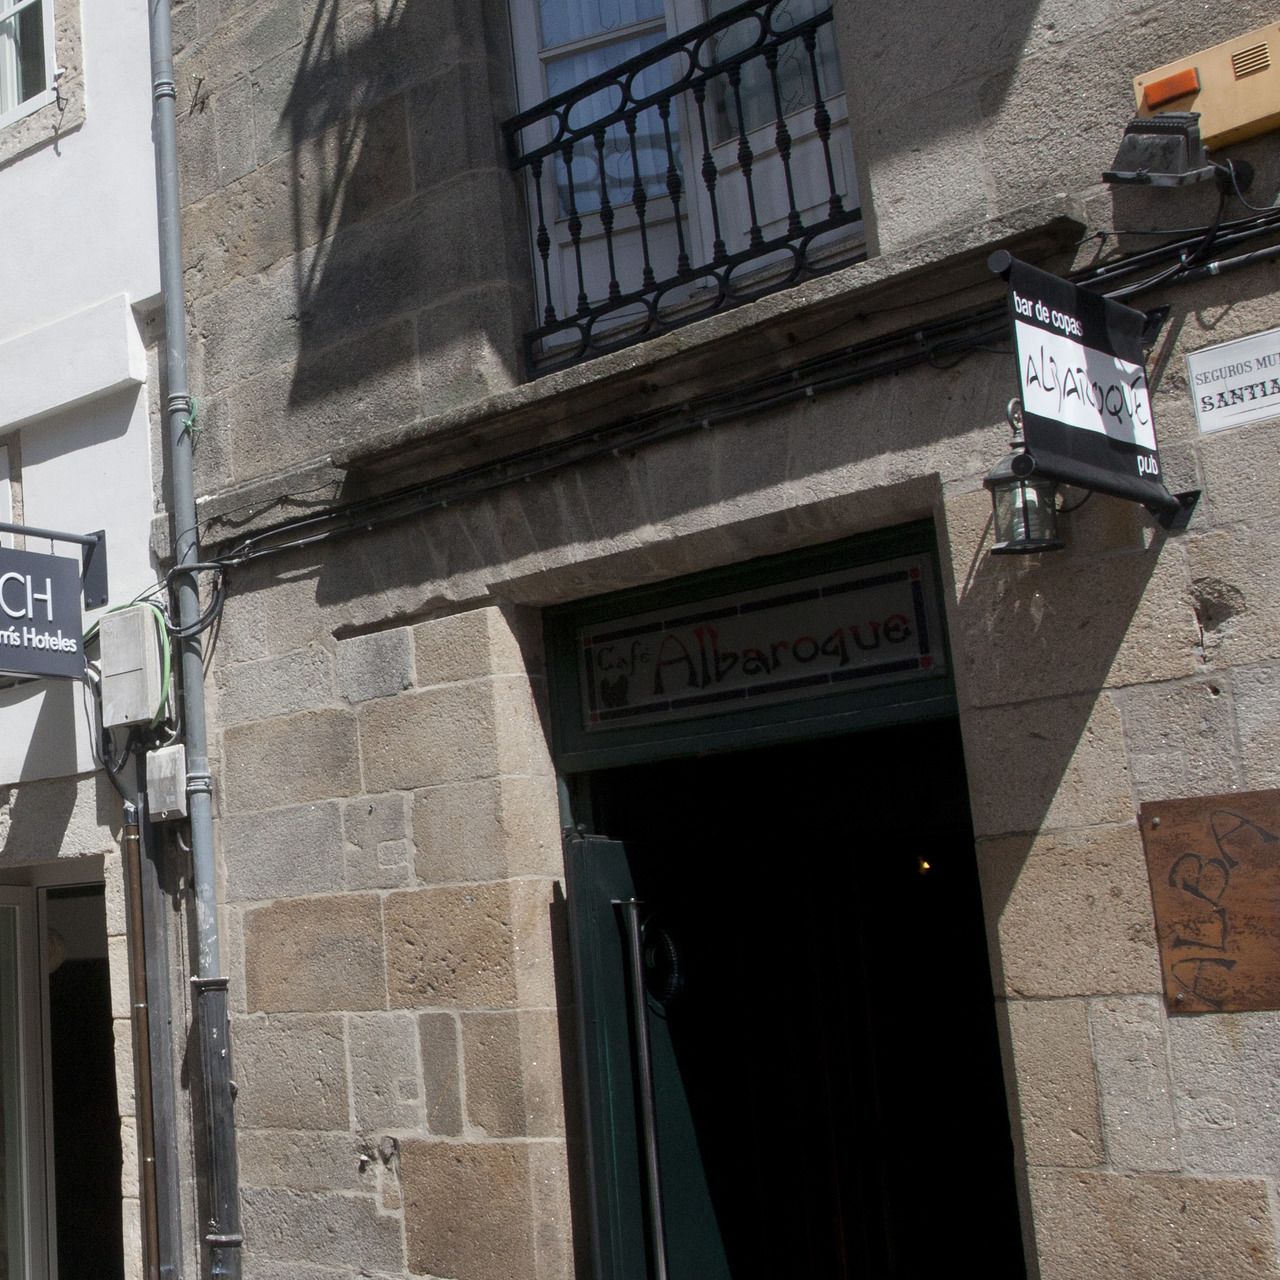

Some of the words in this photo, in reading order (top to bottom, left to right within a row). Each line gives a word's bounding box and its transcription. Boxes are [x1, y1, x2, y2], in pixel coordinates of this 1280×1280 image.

[1013, 291, 1033, 317] bar
[1035, 300, 1050, 323] de
[1051, 310, 1084, 337] copas
[1026, 345, 1149, 425] ALBAROQUE
[1195, 360, 1253, 386] SEGUROS
[1256, 352, 1280, 371] MU
[1136, 454, 1159, 477] pub
[23, 628, 78, 653] Hoteles
[653, 613, 913, 696] Albaroque
